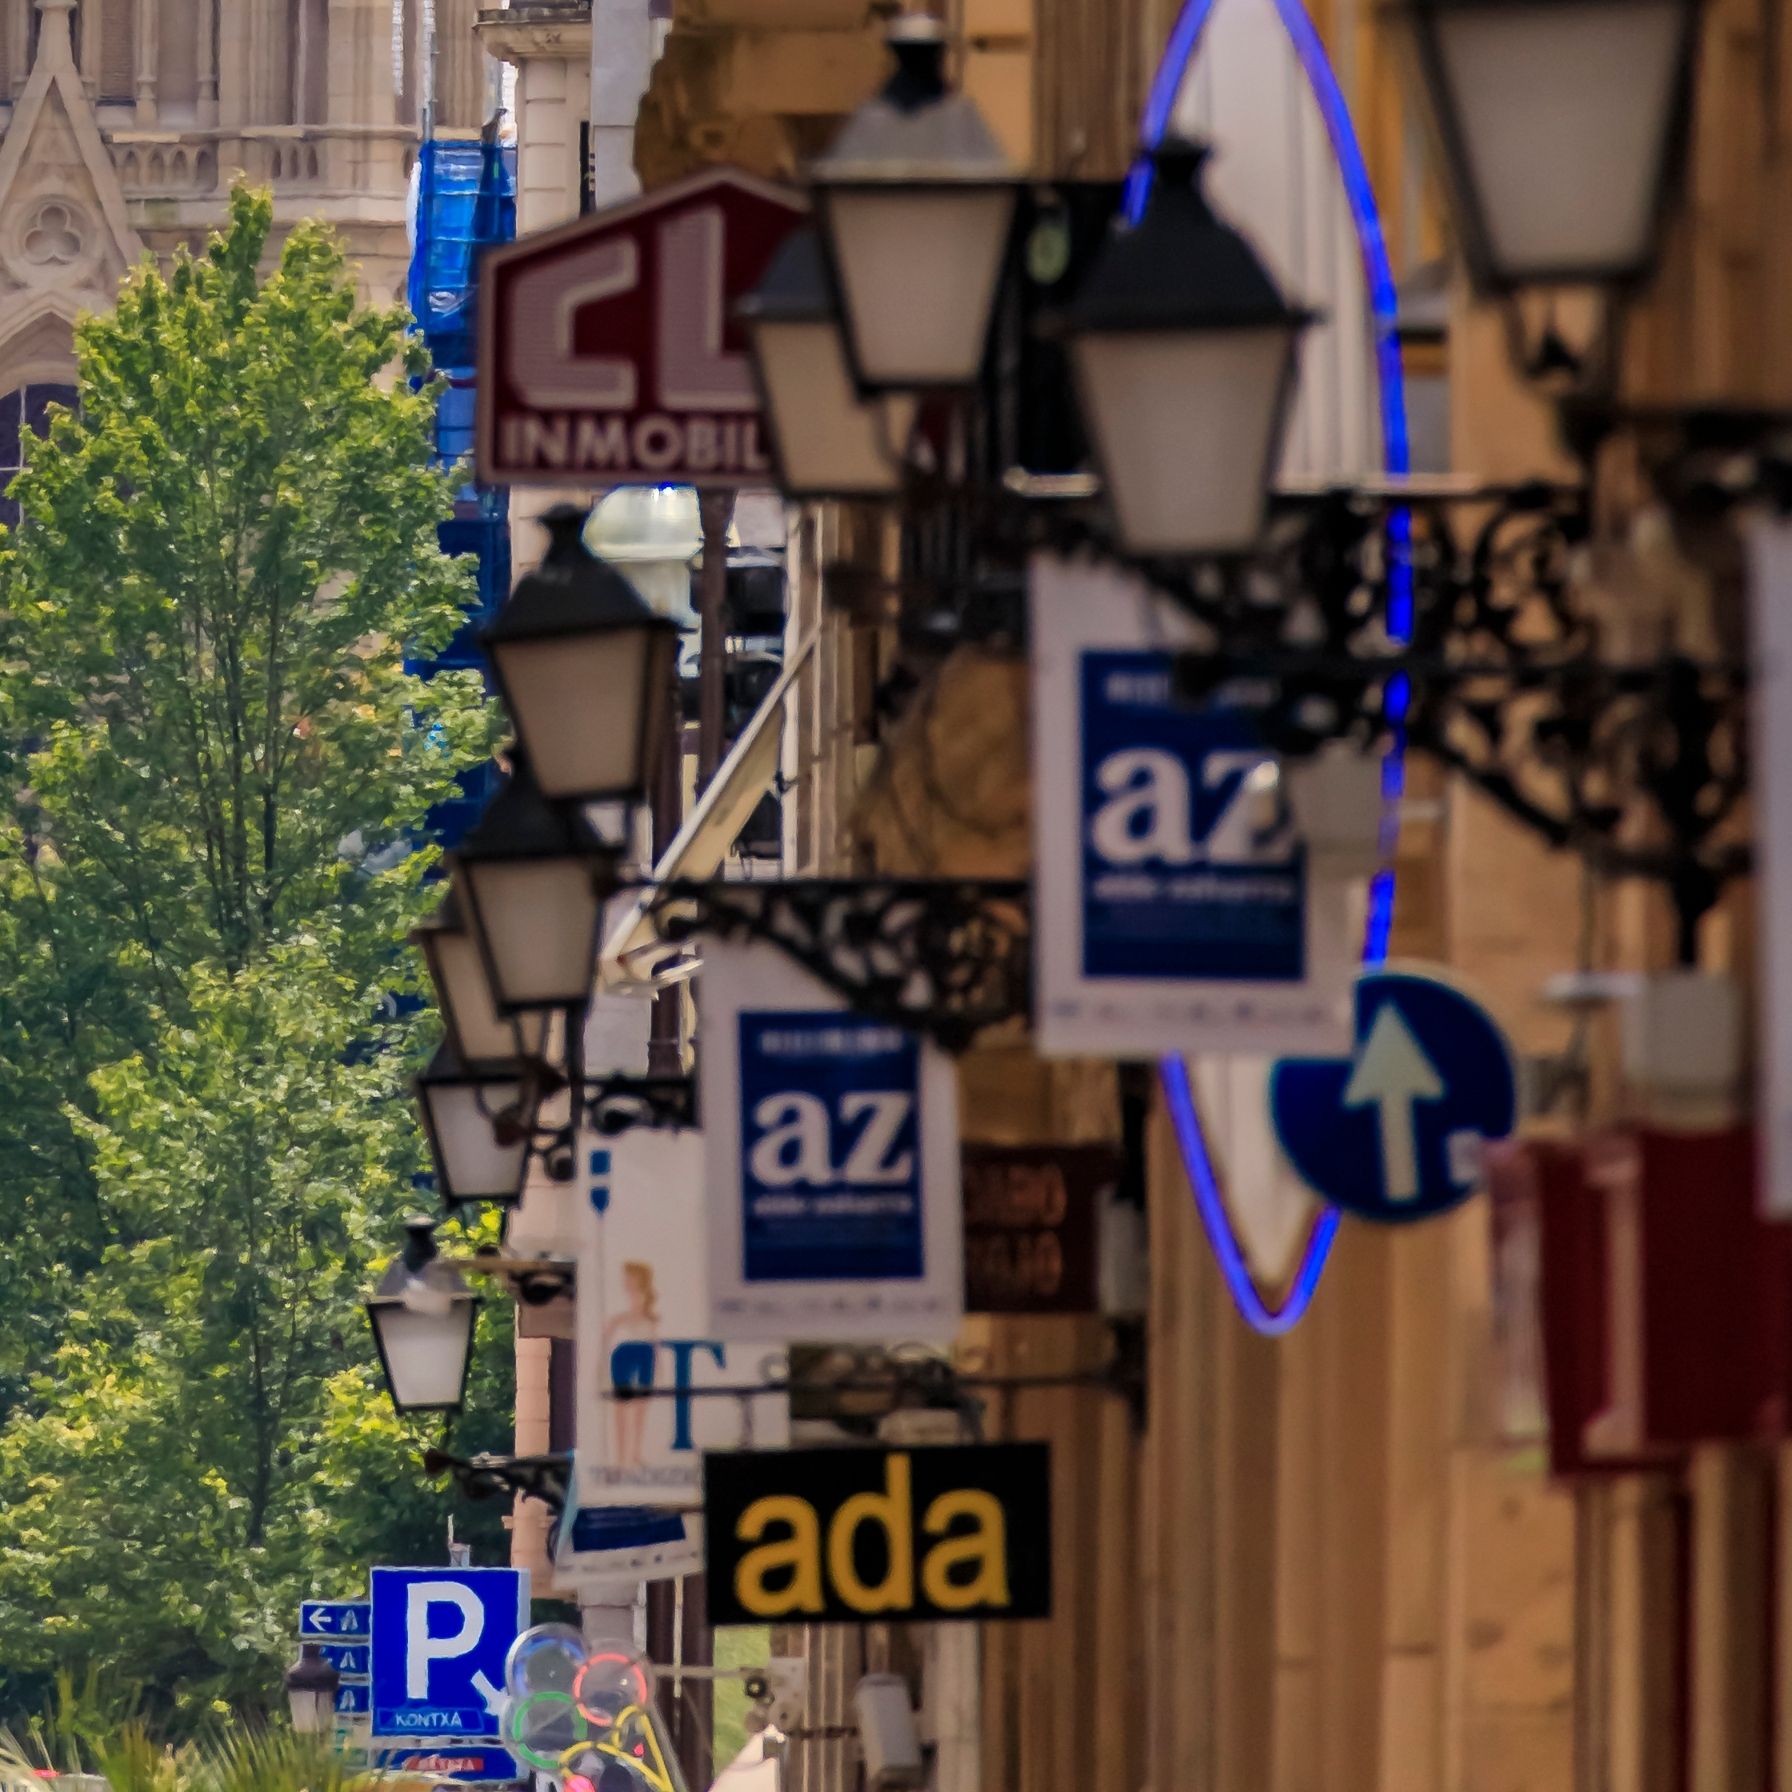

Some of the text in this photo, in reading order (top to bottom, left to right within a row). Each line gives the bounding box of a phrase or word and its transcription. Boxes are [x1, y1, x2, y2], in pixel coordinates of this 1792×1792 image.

[509, 417, 773, 471] INMOBIL
[1092, 747, 1294, 864] az
[751, 1091, 915, 1186] az
[659, 1338, 727, 1450] T
[734, 1452, 1011, 1615] ada
[407, 1581, 485, 1699] P
[394, 1712, 463, 1728] KONTXA
